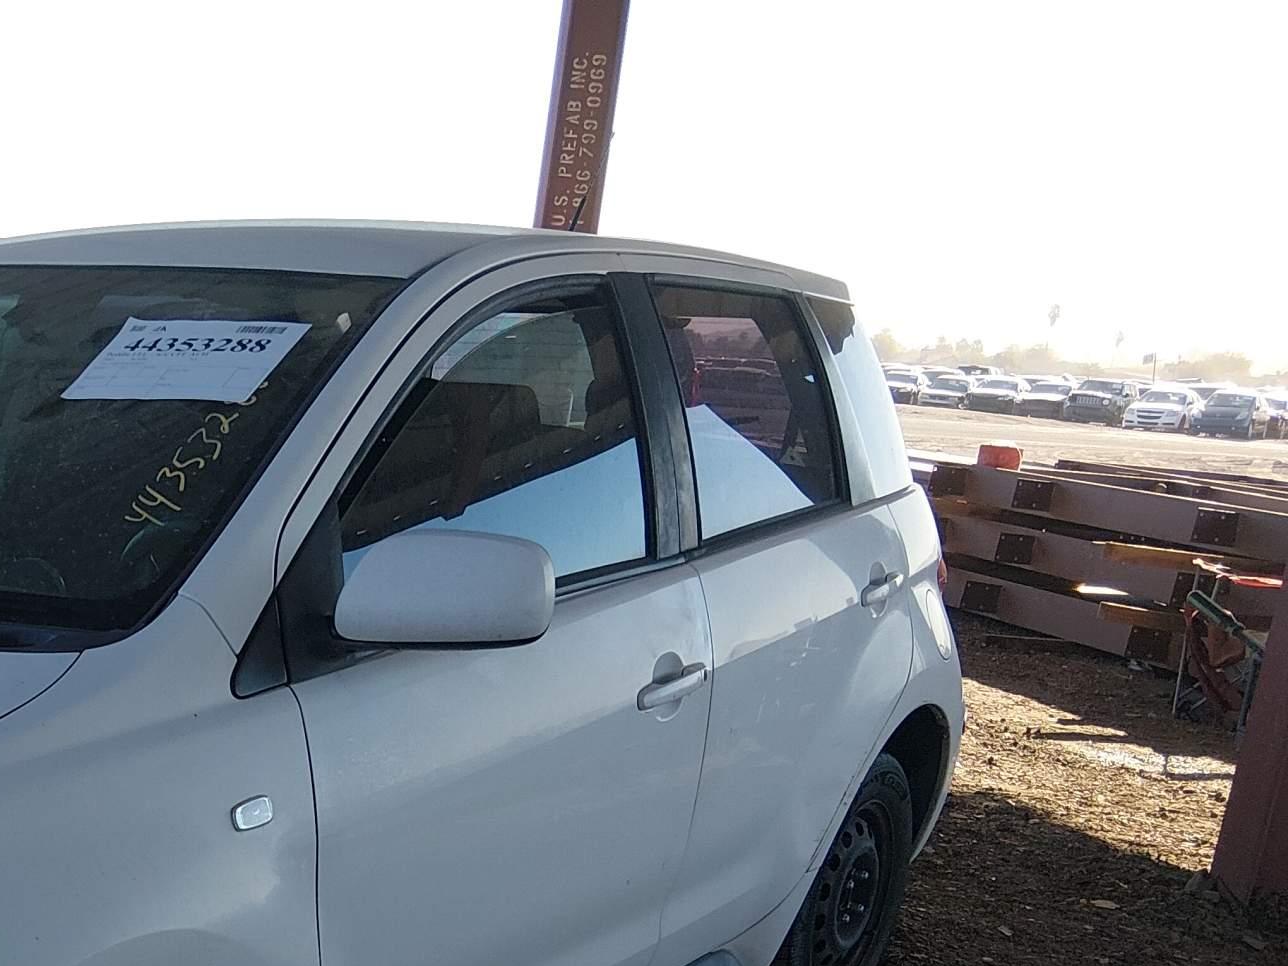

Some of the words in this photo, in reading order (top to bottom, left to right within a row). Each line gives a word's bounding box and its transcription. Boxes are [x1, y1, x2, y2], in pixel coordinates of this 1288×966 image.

[570, 51, 589, 89] INC.
[558, 100, 582, 178] PREFAB
[551, 189, 571, 226] U.S.
[124, 336, 272, 353] 44353288
